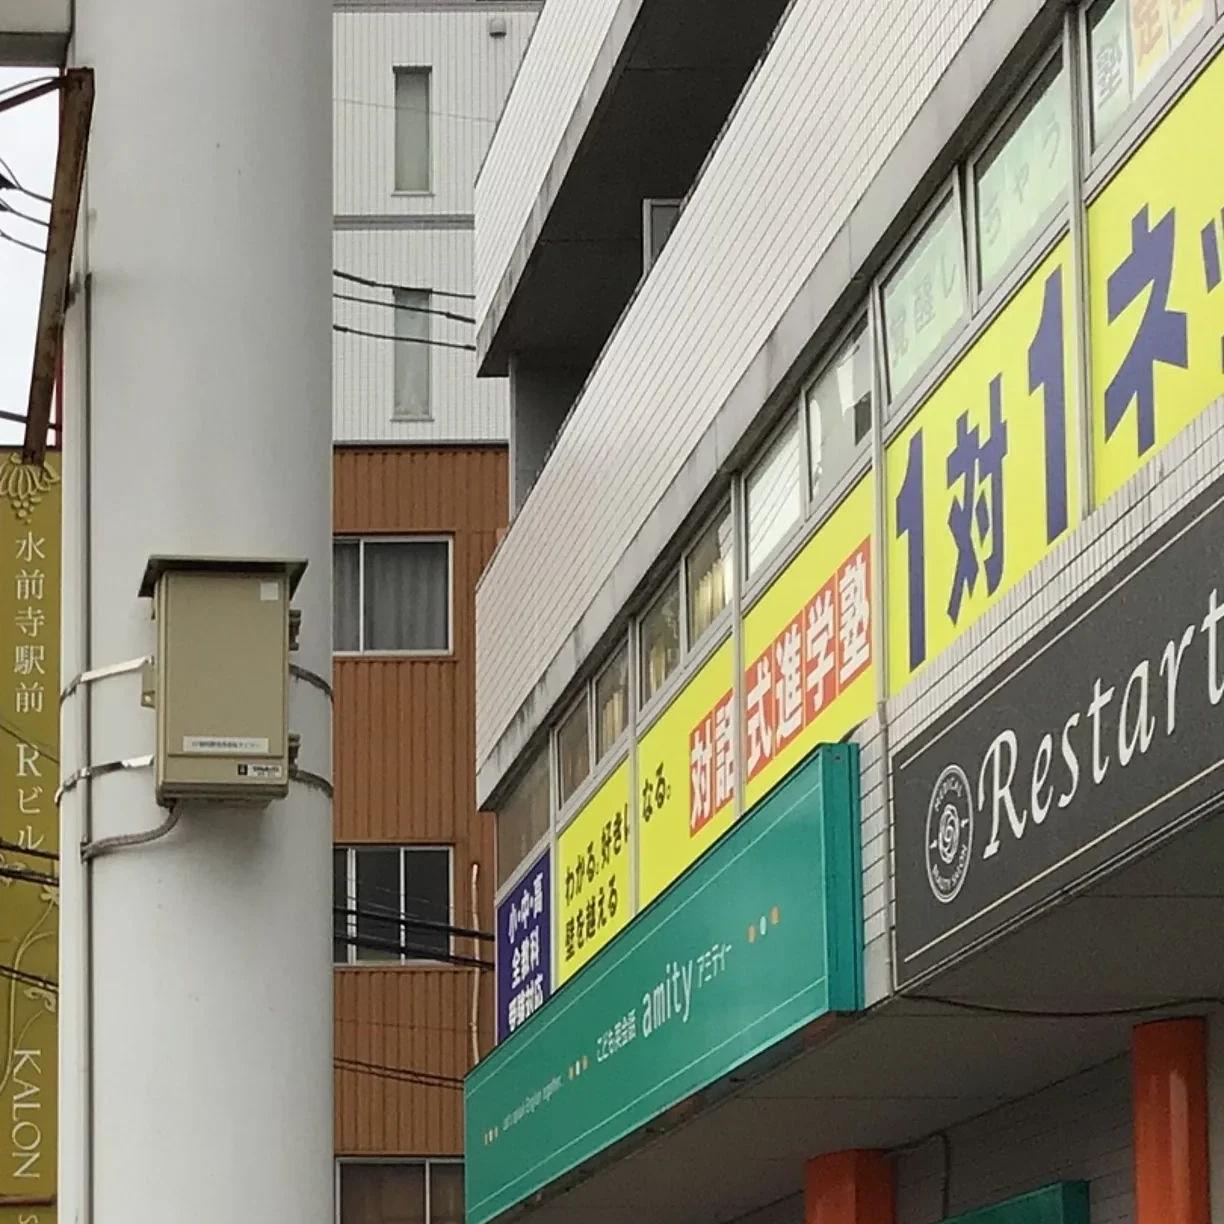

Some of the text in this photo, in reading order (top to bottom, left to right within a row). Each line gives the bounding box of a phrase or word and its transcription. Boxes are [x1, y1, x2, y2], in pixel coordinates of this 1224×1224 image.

[14, 530, 46, 850] 水前寺駅前 Rビル
[691, 551, 871, 829] 対話式進学塾
[977, 588, 1224, 859] Restart
[11, 1049, 41, 1178] KALON
[642, 960, 693, 1038] amity
